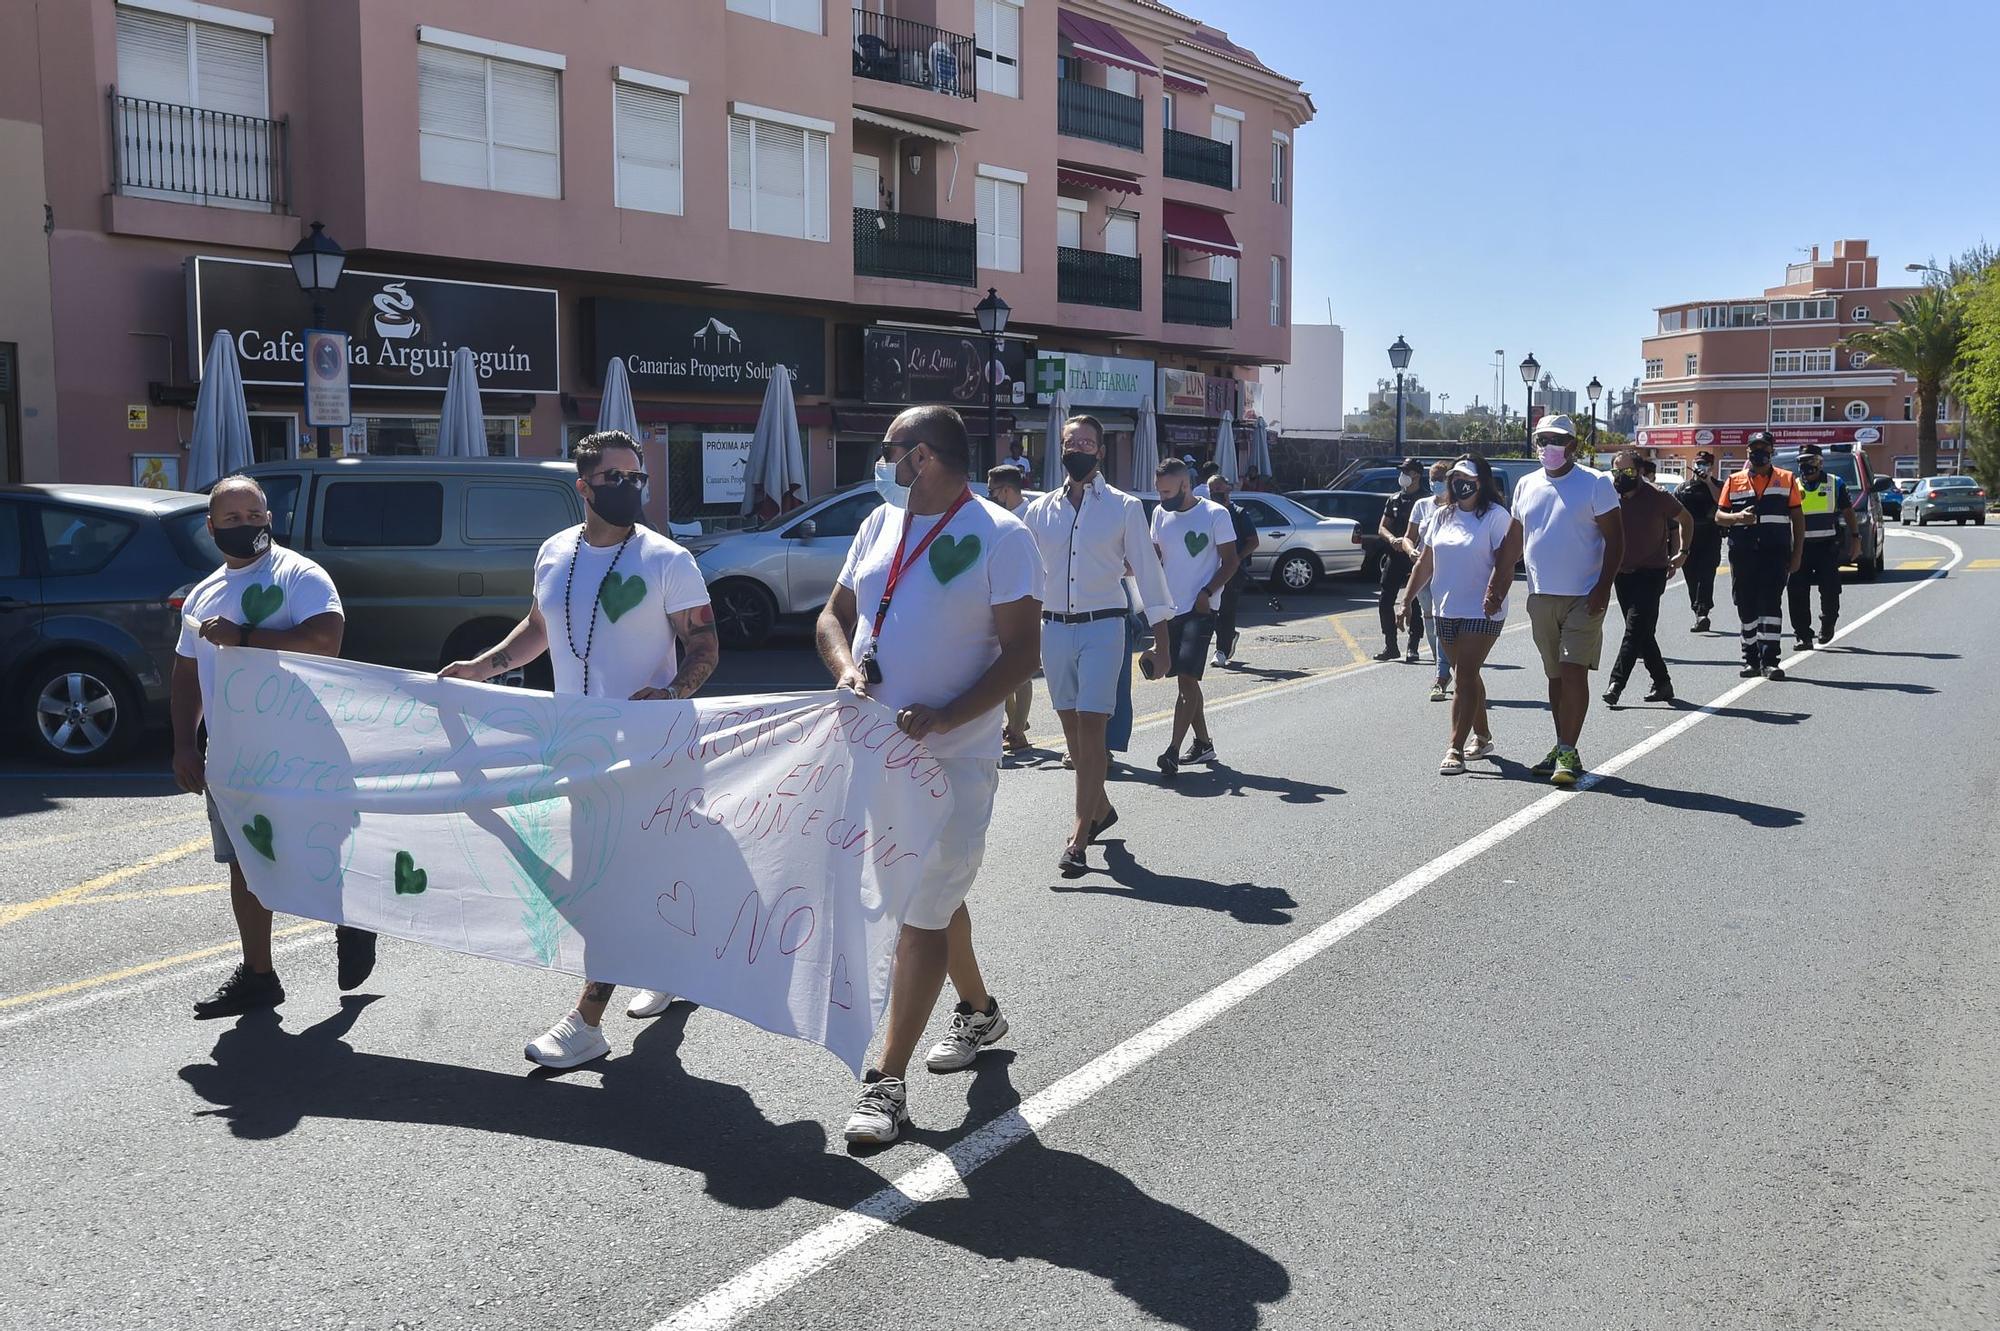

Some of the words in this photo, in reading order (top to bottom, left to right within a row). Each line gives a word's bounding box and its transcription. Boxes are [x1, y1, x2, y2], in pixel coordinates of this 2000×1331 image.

[238, 329, 369, 366] Cafeía
[628, 354, 687, 376] Canarias
[690, 358, 742, 382] Property
[706, 439, 738, 450] PRÓXIMA
[740, 441, 753, 450] APE
[777, 763, 843, 796] EN
[716, 886, 815, 964] NO
